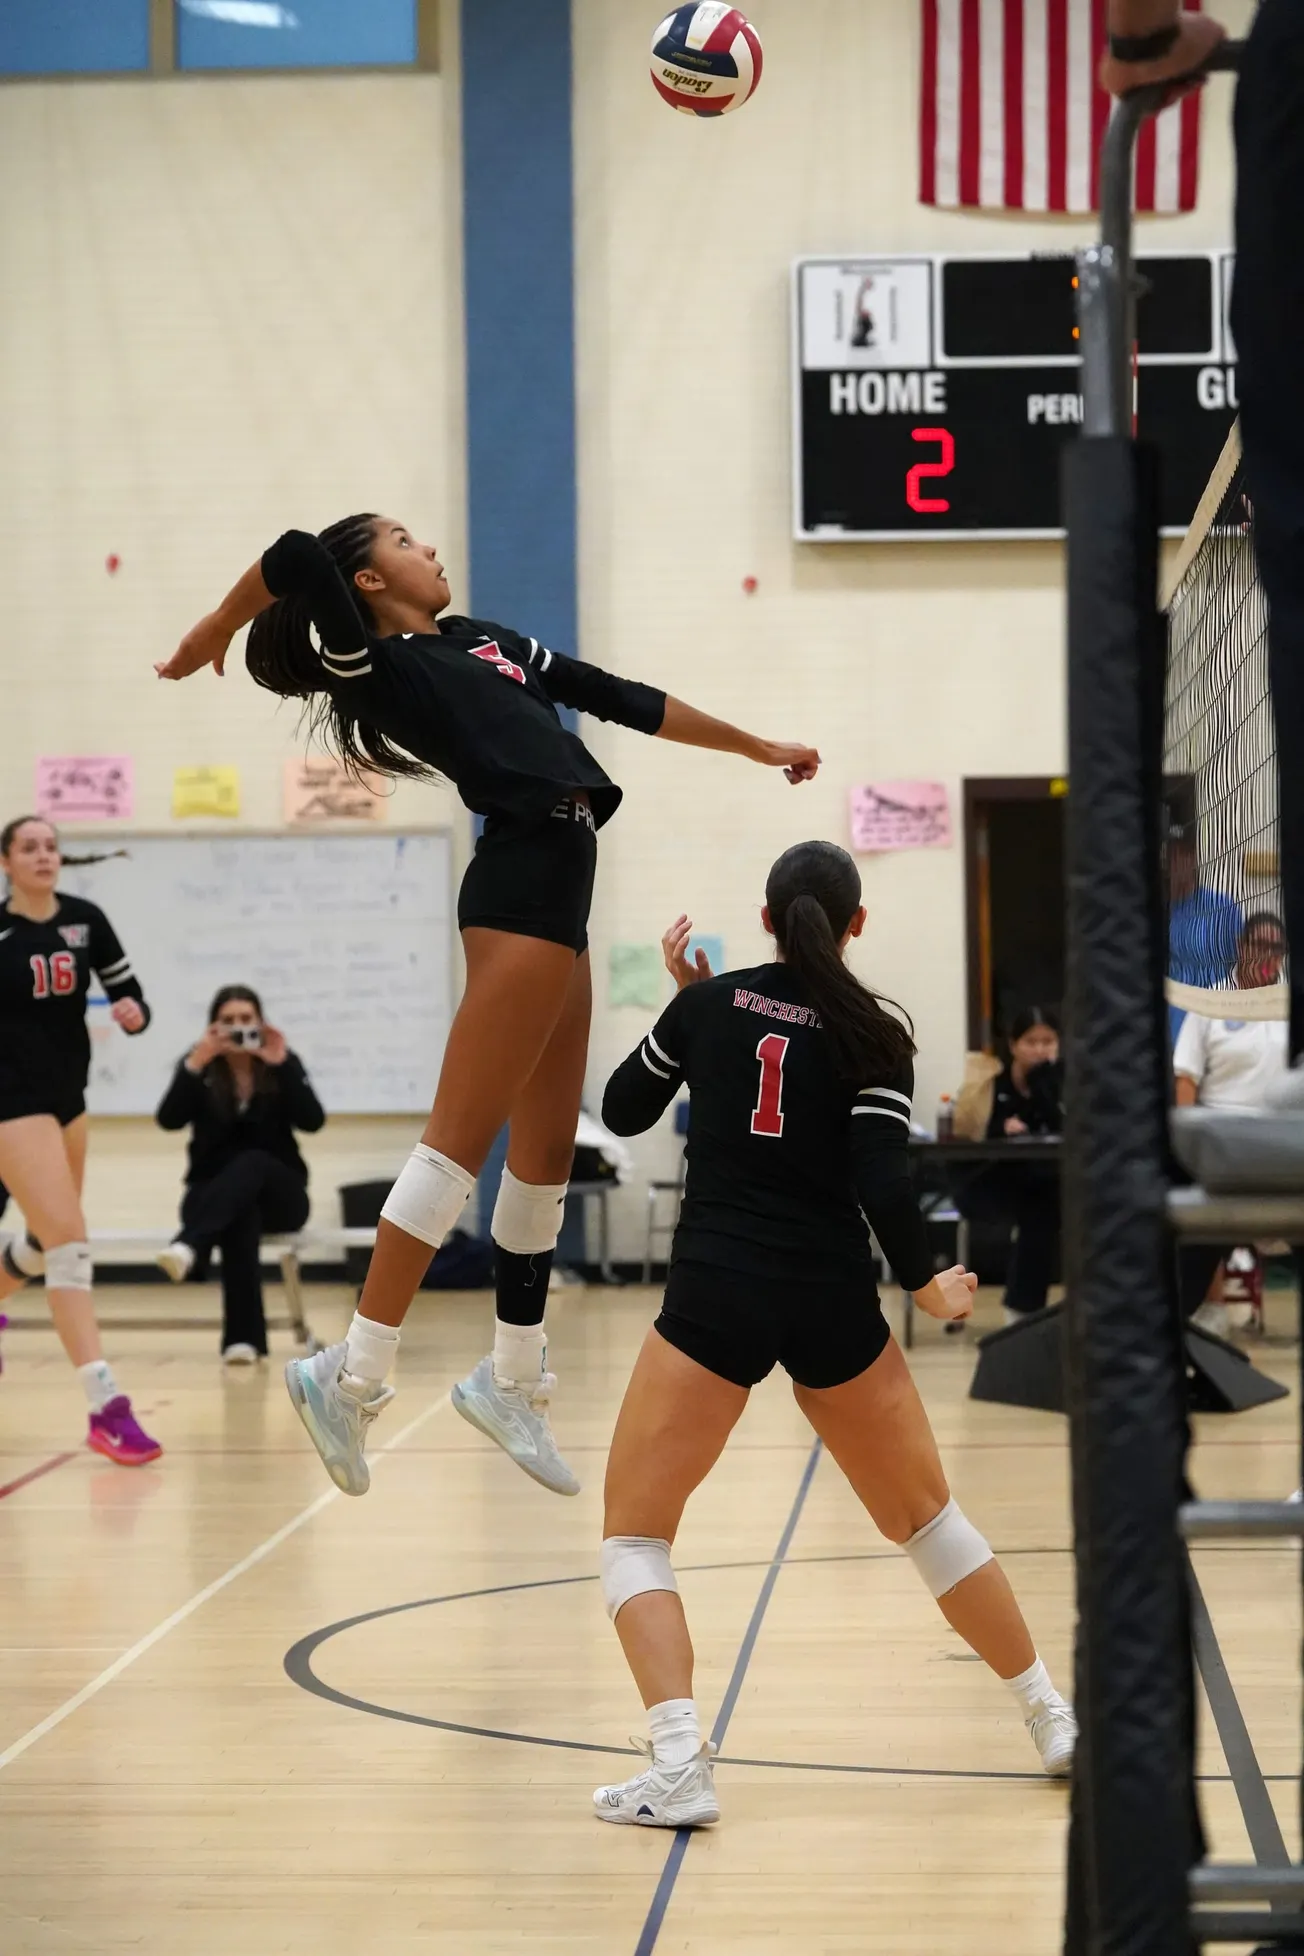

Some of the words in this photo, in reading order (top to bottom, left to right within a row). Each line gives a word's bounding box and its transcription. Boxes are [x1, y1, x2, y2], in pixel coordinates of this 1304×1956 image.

[662, 68, 713, 94] Baden
[829, 371, 948, 415] HOME
[906, 427, 955, 513] 2
[30, 950, 77, 999] 16
[733, 988, 823, 1029] WINCHEST
[751, 1032, 790, 1138] 1
